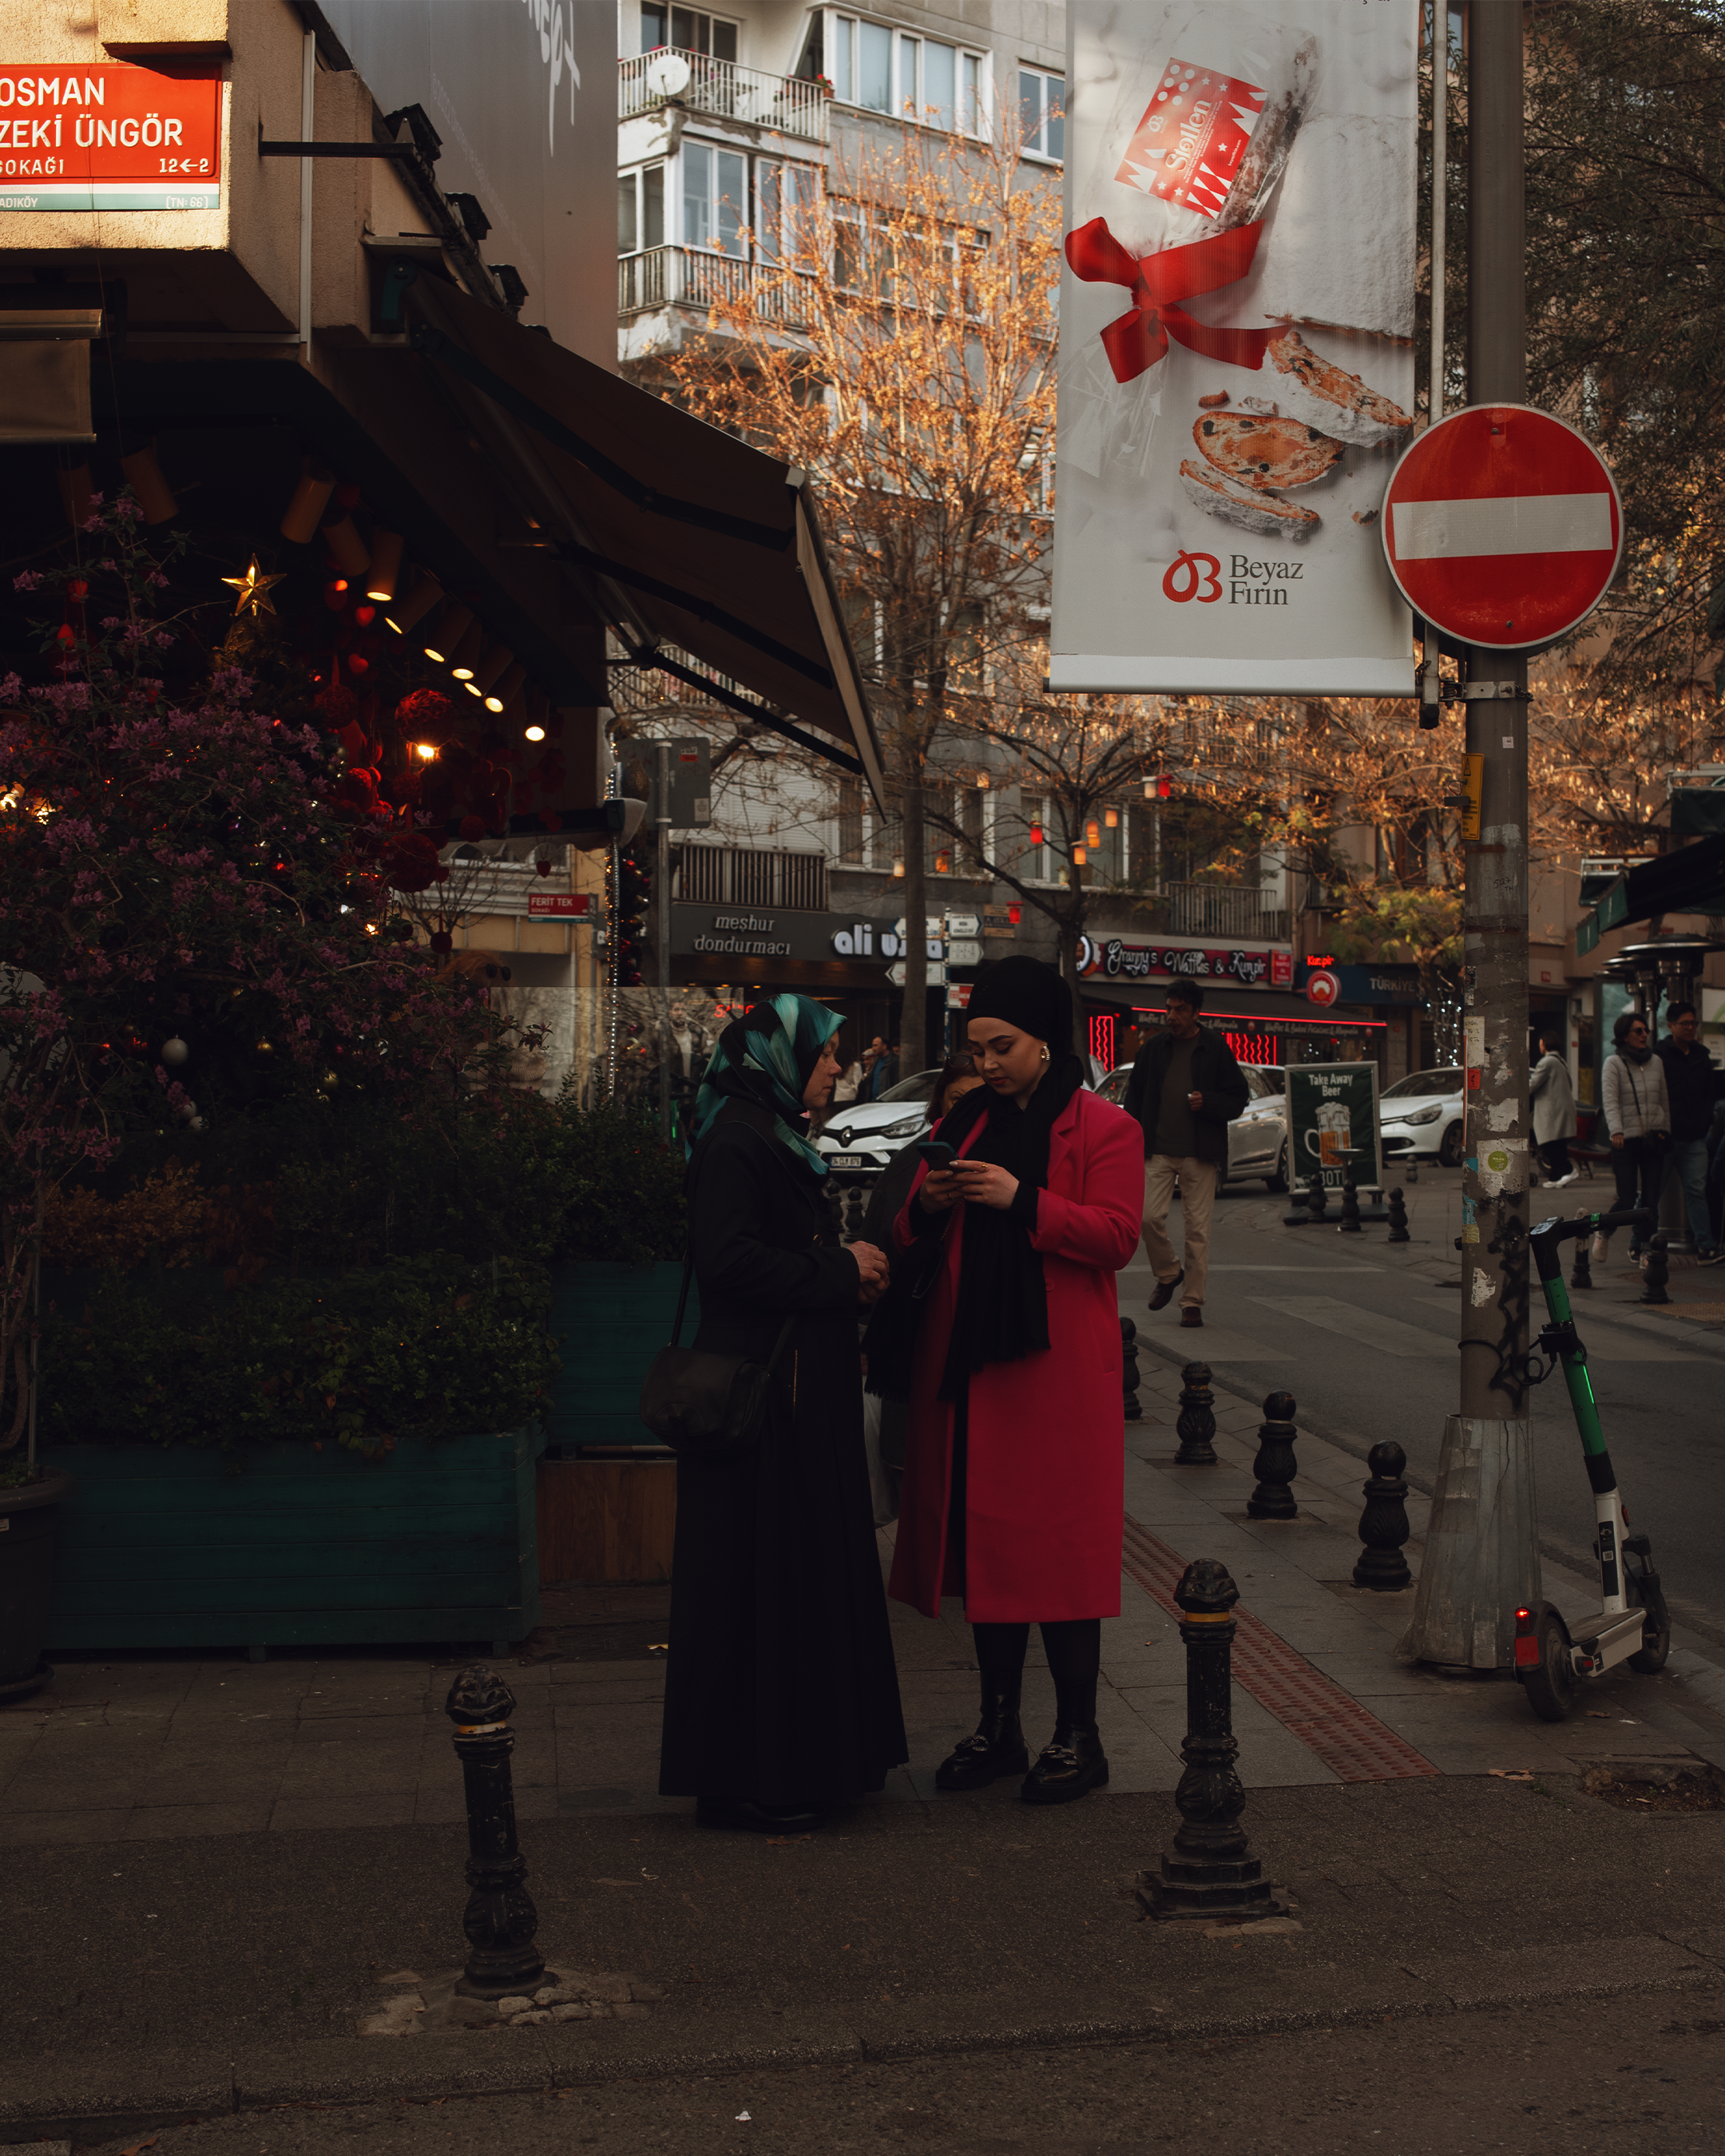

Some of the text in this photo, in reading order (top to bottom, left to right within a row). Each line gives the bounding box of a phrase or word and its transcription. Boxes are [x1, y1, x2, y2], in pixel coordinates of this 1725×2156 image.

[0, 77, 105, 106] OSMAN
[0, 113, 183, 148] ZEKİ ÜNGÖR
[1164, 100, 1212, 172] Stollen
[160, 158, 178, 173] 12
[200, 158, 209, 173] 2
[0, 195, 38, 208] ADIKÖY
[1228, 554, 1303, 585] Beyaz
[1228, 581, 1289, 605] Fırın
[530, 895, 573, 907] FERİT TEK
[714, 914, 775, 933] meşhur
[693, 934, 791, 956] dondurmacı
[831, 923, 873, 957] ali
[1106, 940, 1267, 982] Granny's Waffles & Kumpir
[1370, 975, 1416, 992] TÜRKİYE
[1308, 1072, 1354, 1087] Take Away
[1322, 1085, 1342, 1097] Beer
